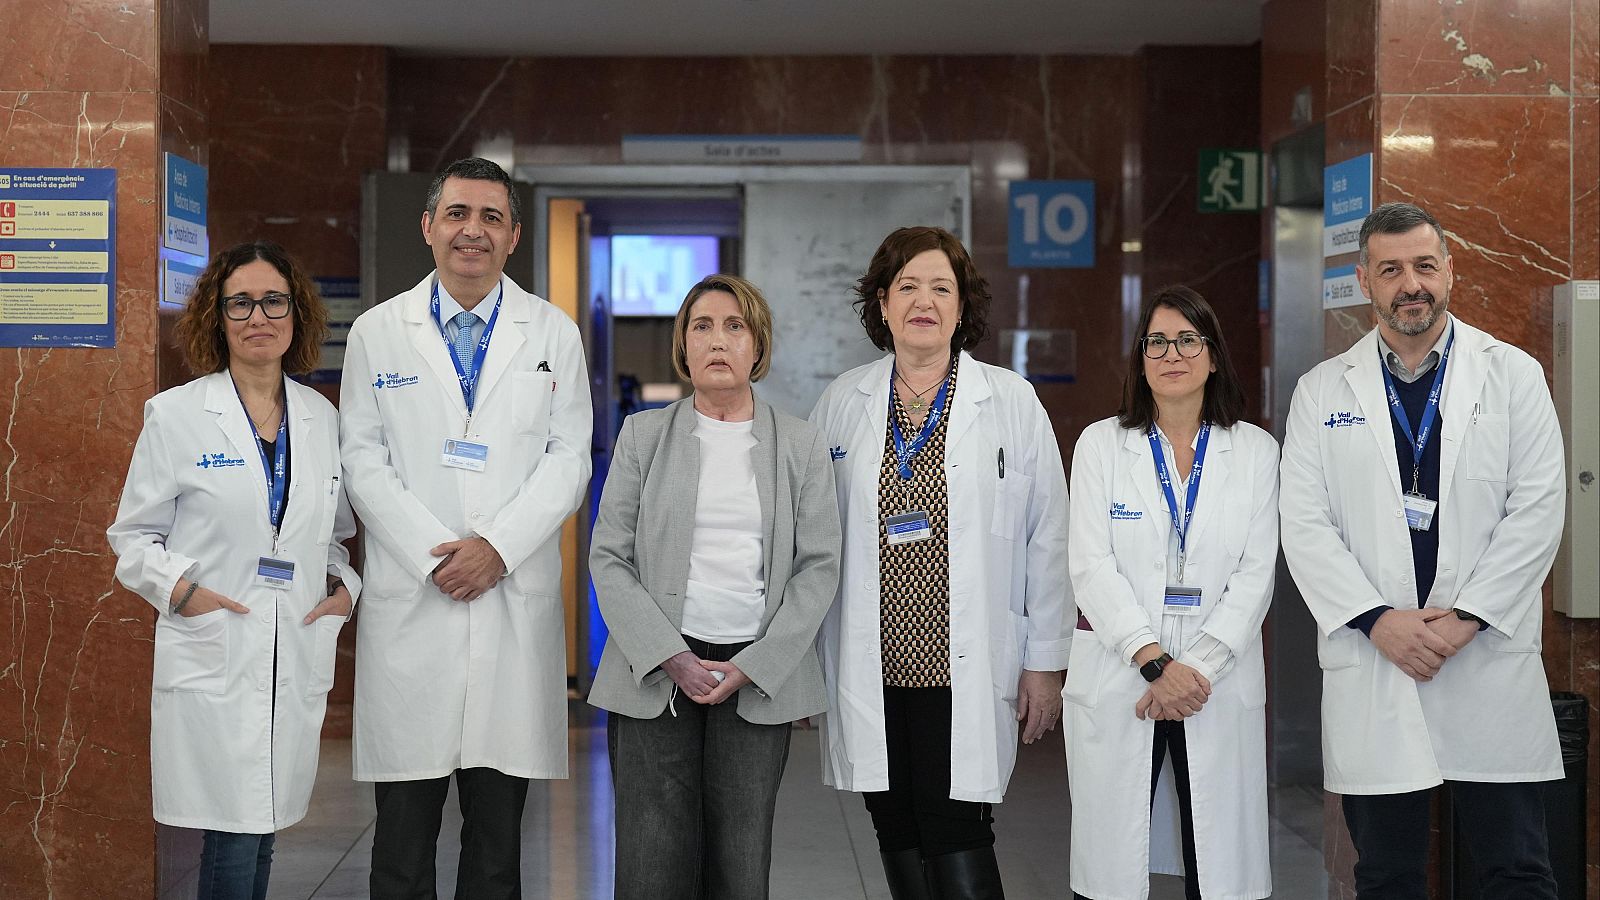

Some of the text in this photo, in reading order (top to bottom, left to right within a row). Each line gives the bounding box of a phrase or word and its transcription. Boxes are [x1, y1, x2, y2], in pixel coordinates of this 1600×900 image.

[703, 143, 781, 157] Sala d'actes
[37, 174, 85, 182] d'emergència
[1014, 193, 1088, 245] 10
[386, 375, 418, 385] d'Hebron
[1113, 502, 1126, 510] Vall
[1112, 509, 1142, 517] d'Hebron
